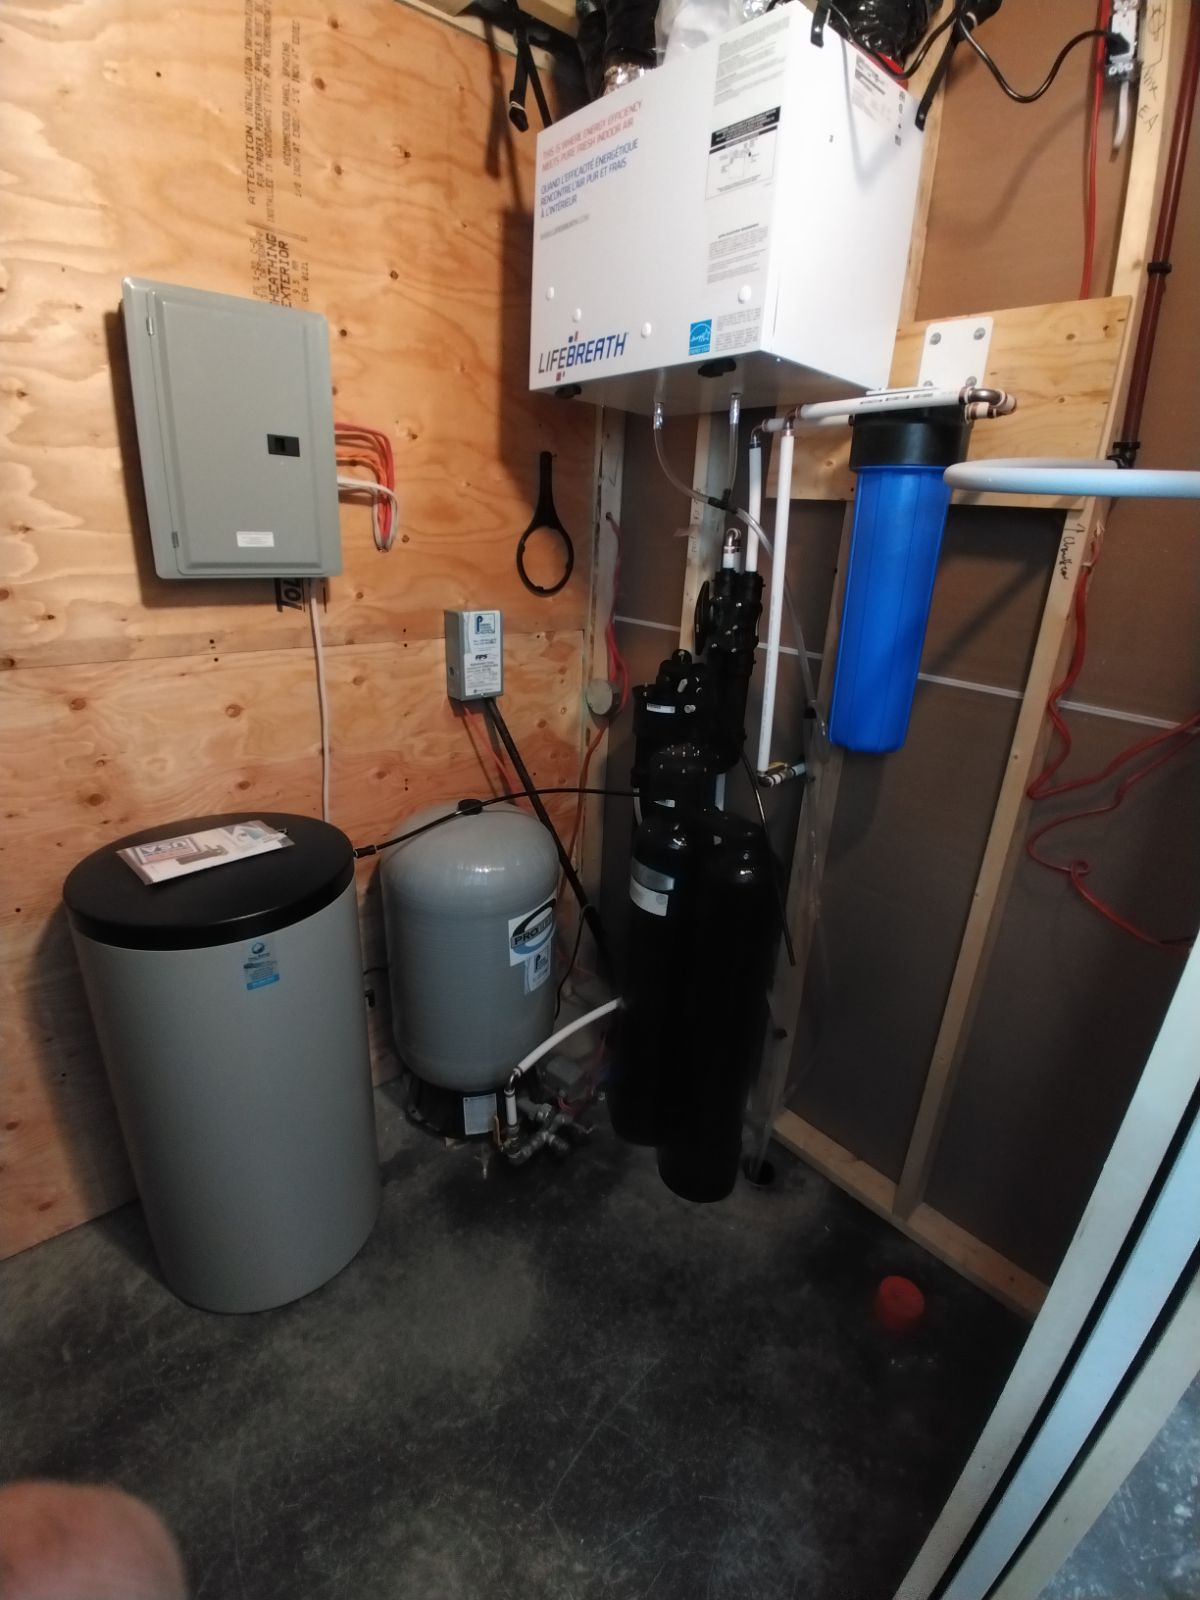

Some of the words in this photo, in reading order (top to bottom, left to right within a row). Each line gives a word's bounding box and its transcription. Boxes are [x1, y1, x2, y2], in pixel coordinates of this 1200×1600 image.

[606, 101, 643, 128] EFFICIENCY
[245, 125, 256, 205] ATTENTION
[540, 184, 572, 206] RENCONTRE
[586, 169, 600, 184] PUR
[600, 164, 609, 178] ET
[608, 158, 628, 173] FRAIS
[541, 178, 561, 195] QUAND
[278, 240, 292, 308] EXTERIOR
[538, 332, 628, 374] LIFEBREATH
